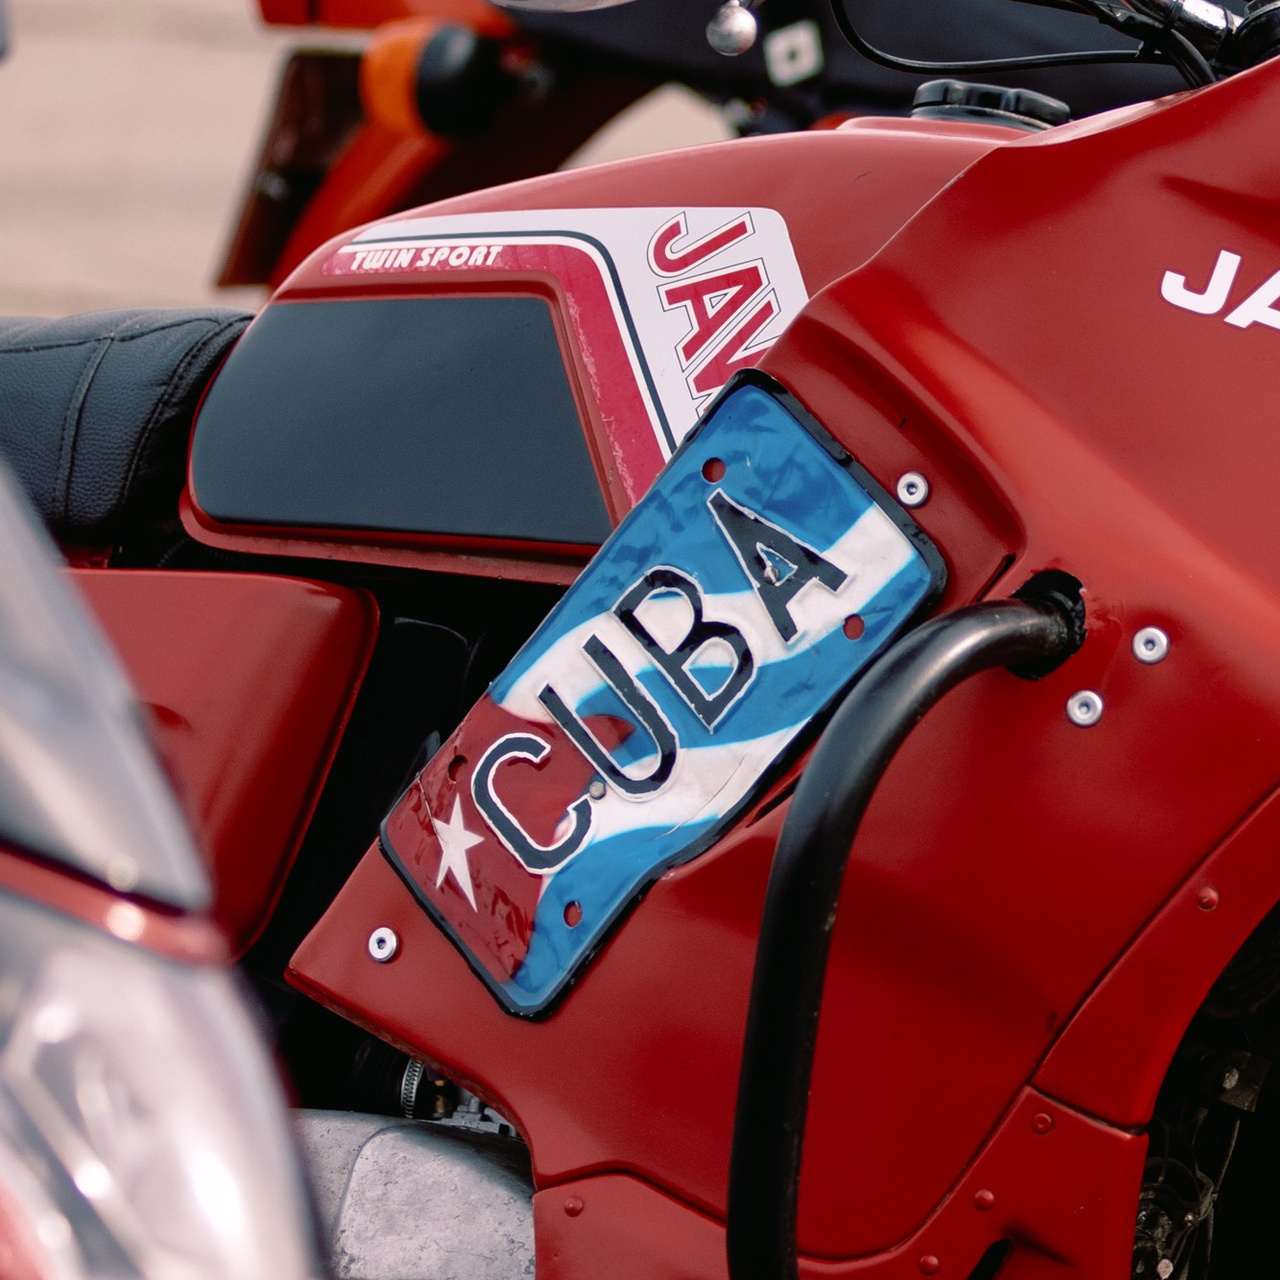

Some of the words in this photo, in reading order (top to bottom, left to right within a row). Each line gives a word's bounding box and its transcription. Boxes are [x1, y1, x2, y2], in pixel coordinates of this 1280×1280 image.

[350, 248, 416, 270] TWIN
[415, 245, 503, 267] SPORT
[471, 487, 850, 875] CUBA
